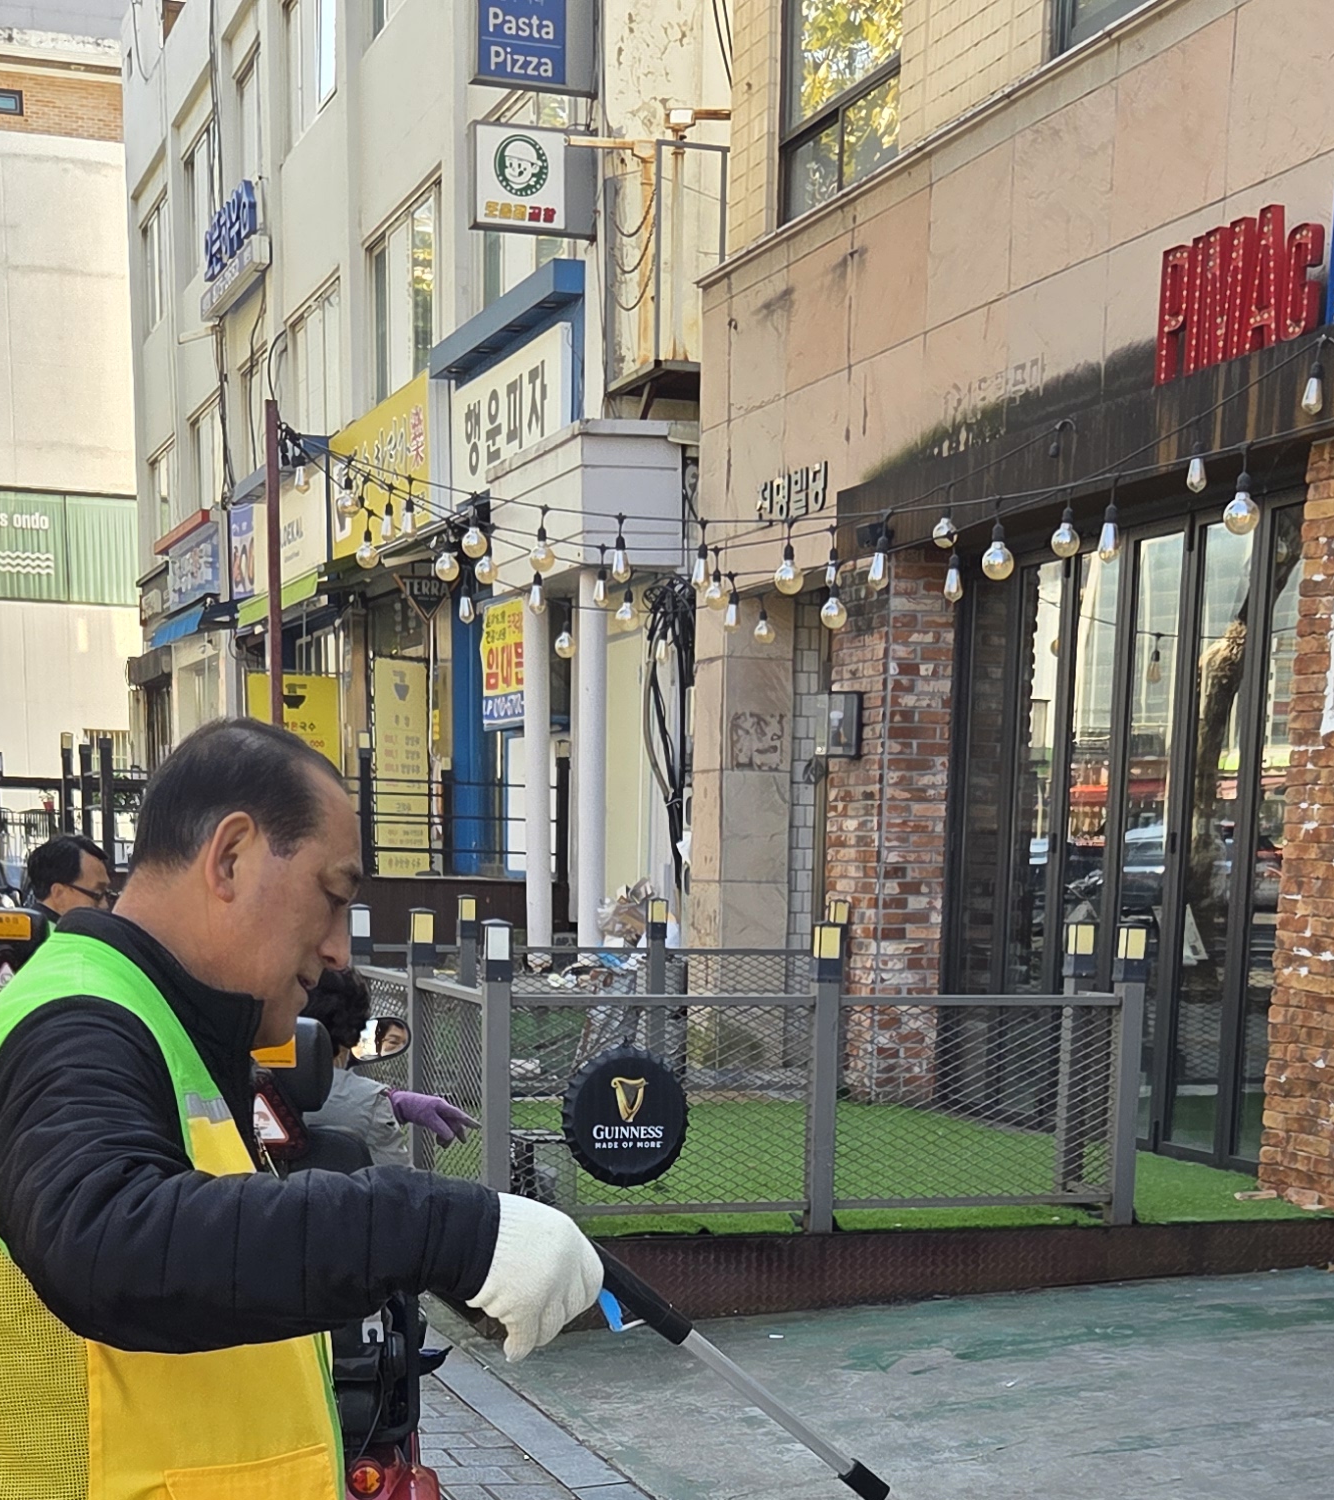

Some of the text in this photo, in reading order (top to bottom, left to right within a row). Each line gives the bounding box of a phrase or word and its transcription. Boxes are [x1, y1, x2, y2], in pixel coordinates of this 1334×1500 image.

[489, 7, 554, 40] Pasta
[490, 45, 553, 77] Pizza
[465, 359, 547, 476] 행운피자
[13, 512, 50, 530] ondo
[402, 578, 451, 598] TERRA
[592, 1125, 664, 1139] GUINNESS
